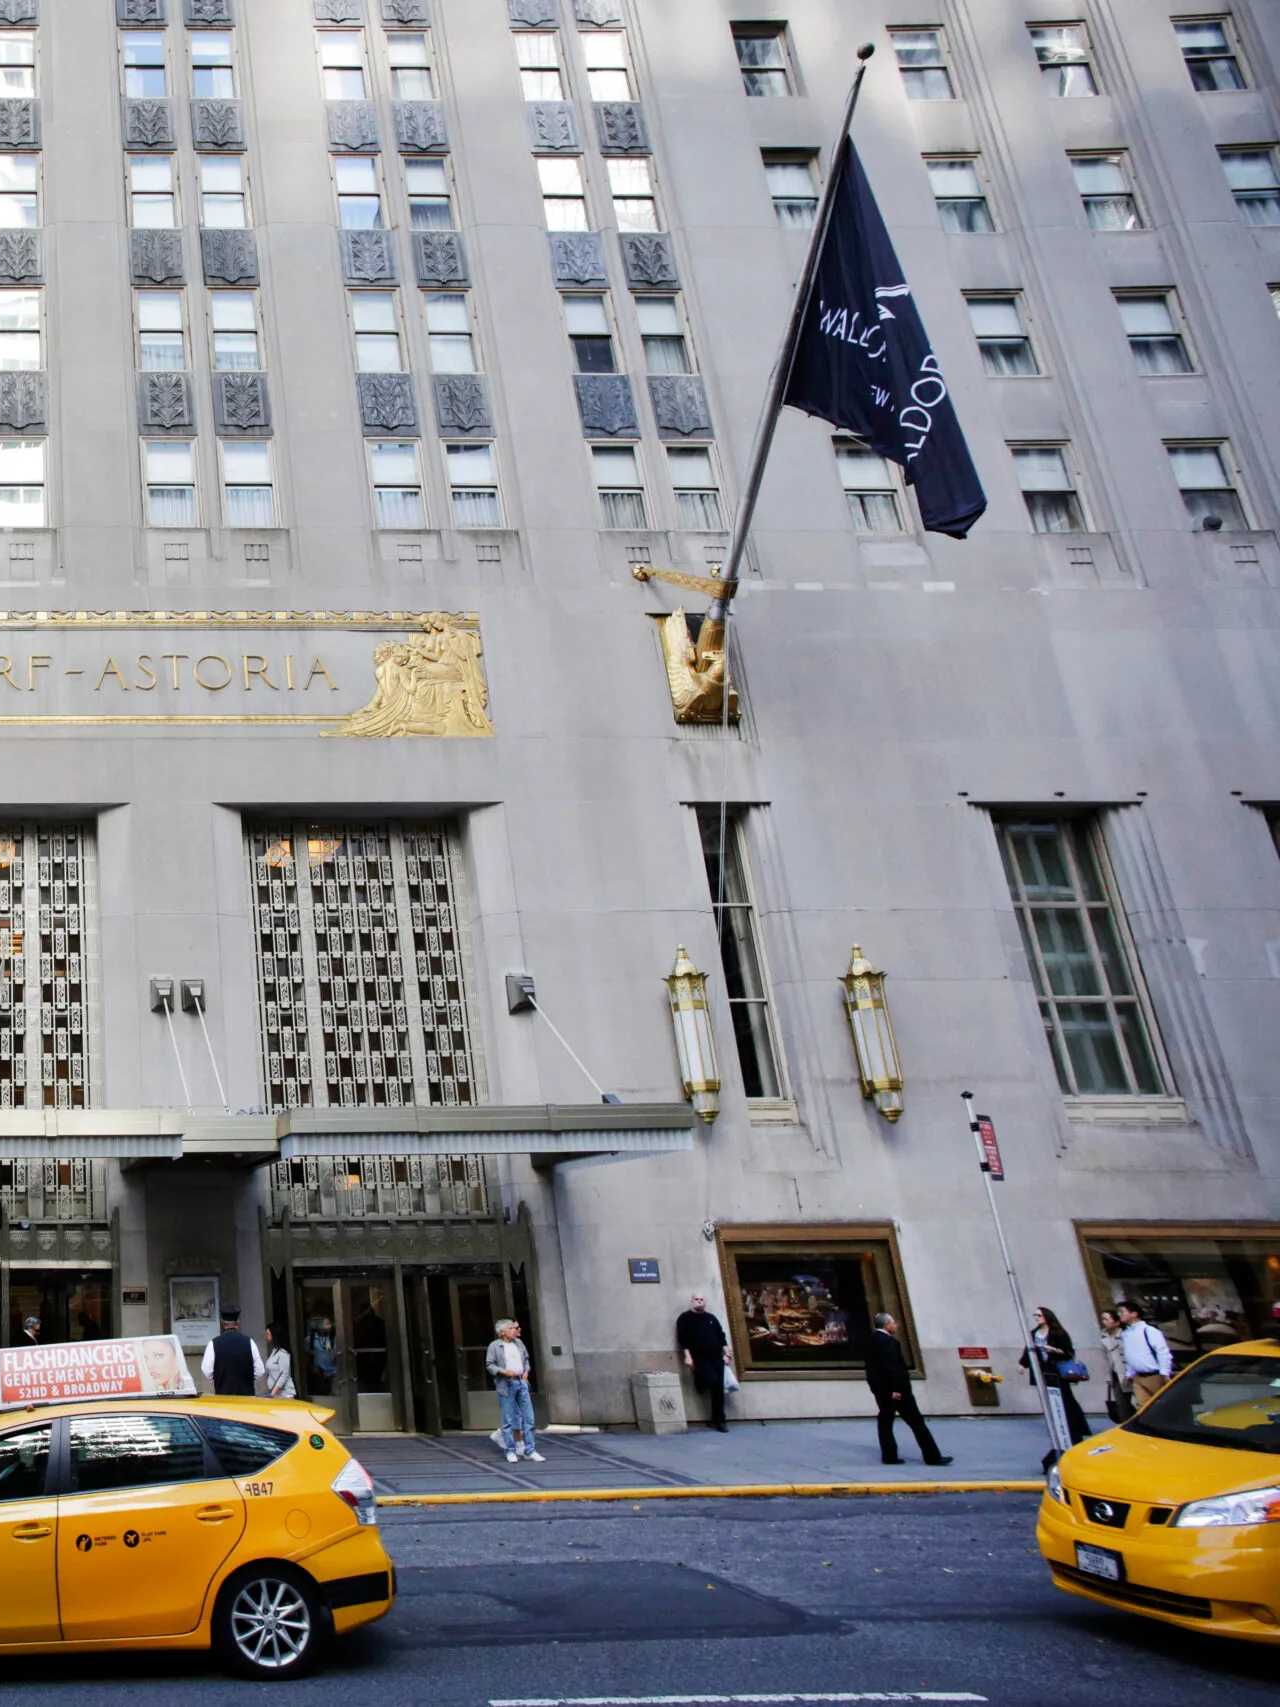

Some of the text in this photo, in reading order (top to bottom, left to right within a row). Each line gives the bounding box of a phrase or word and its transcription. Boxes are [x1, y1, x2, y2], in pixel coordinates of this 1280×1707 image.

[3, 1343, 135, 1372] FLASHDANCERS
[3, 1364, 136, 1387] GENTLEMEN'S CLUB
[19, 1380, 124, 1399] 52ND & BROADWAY
